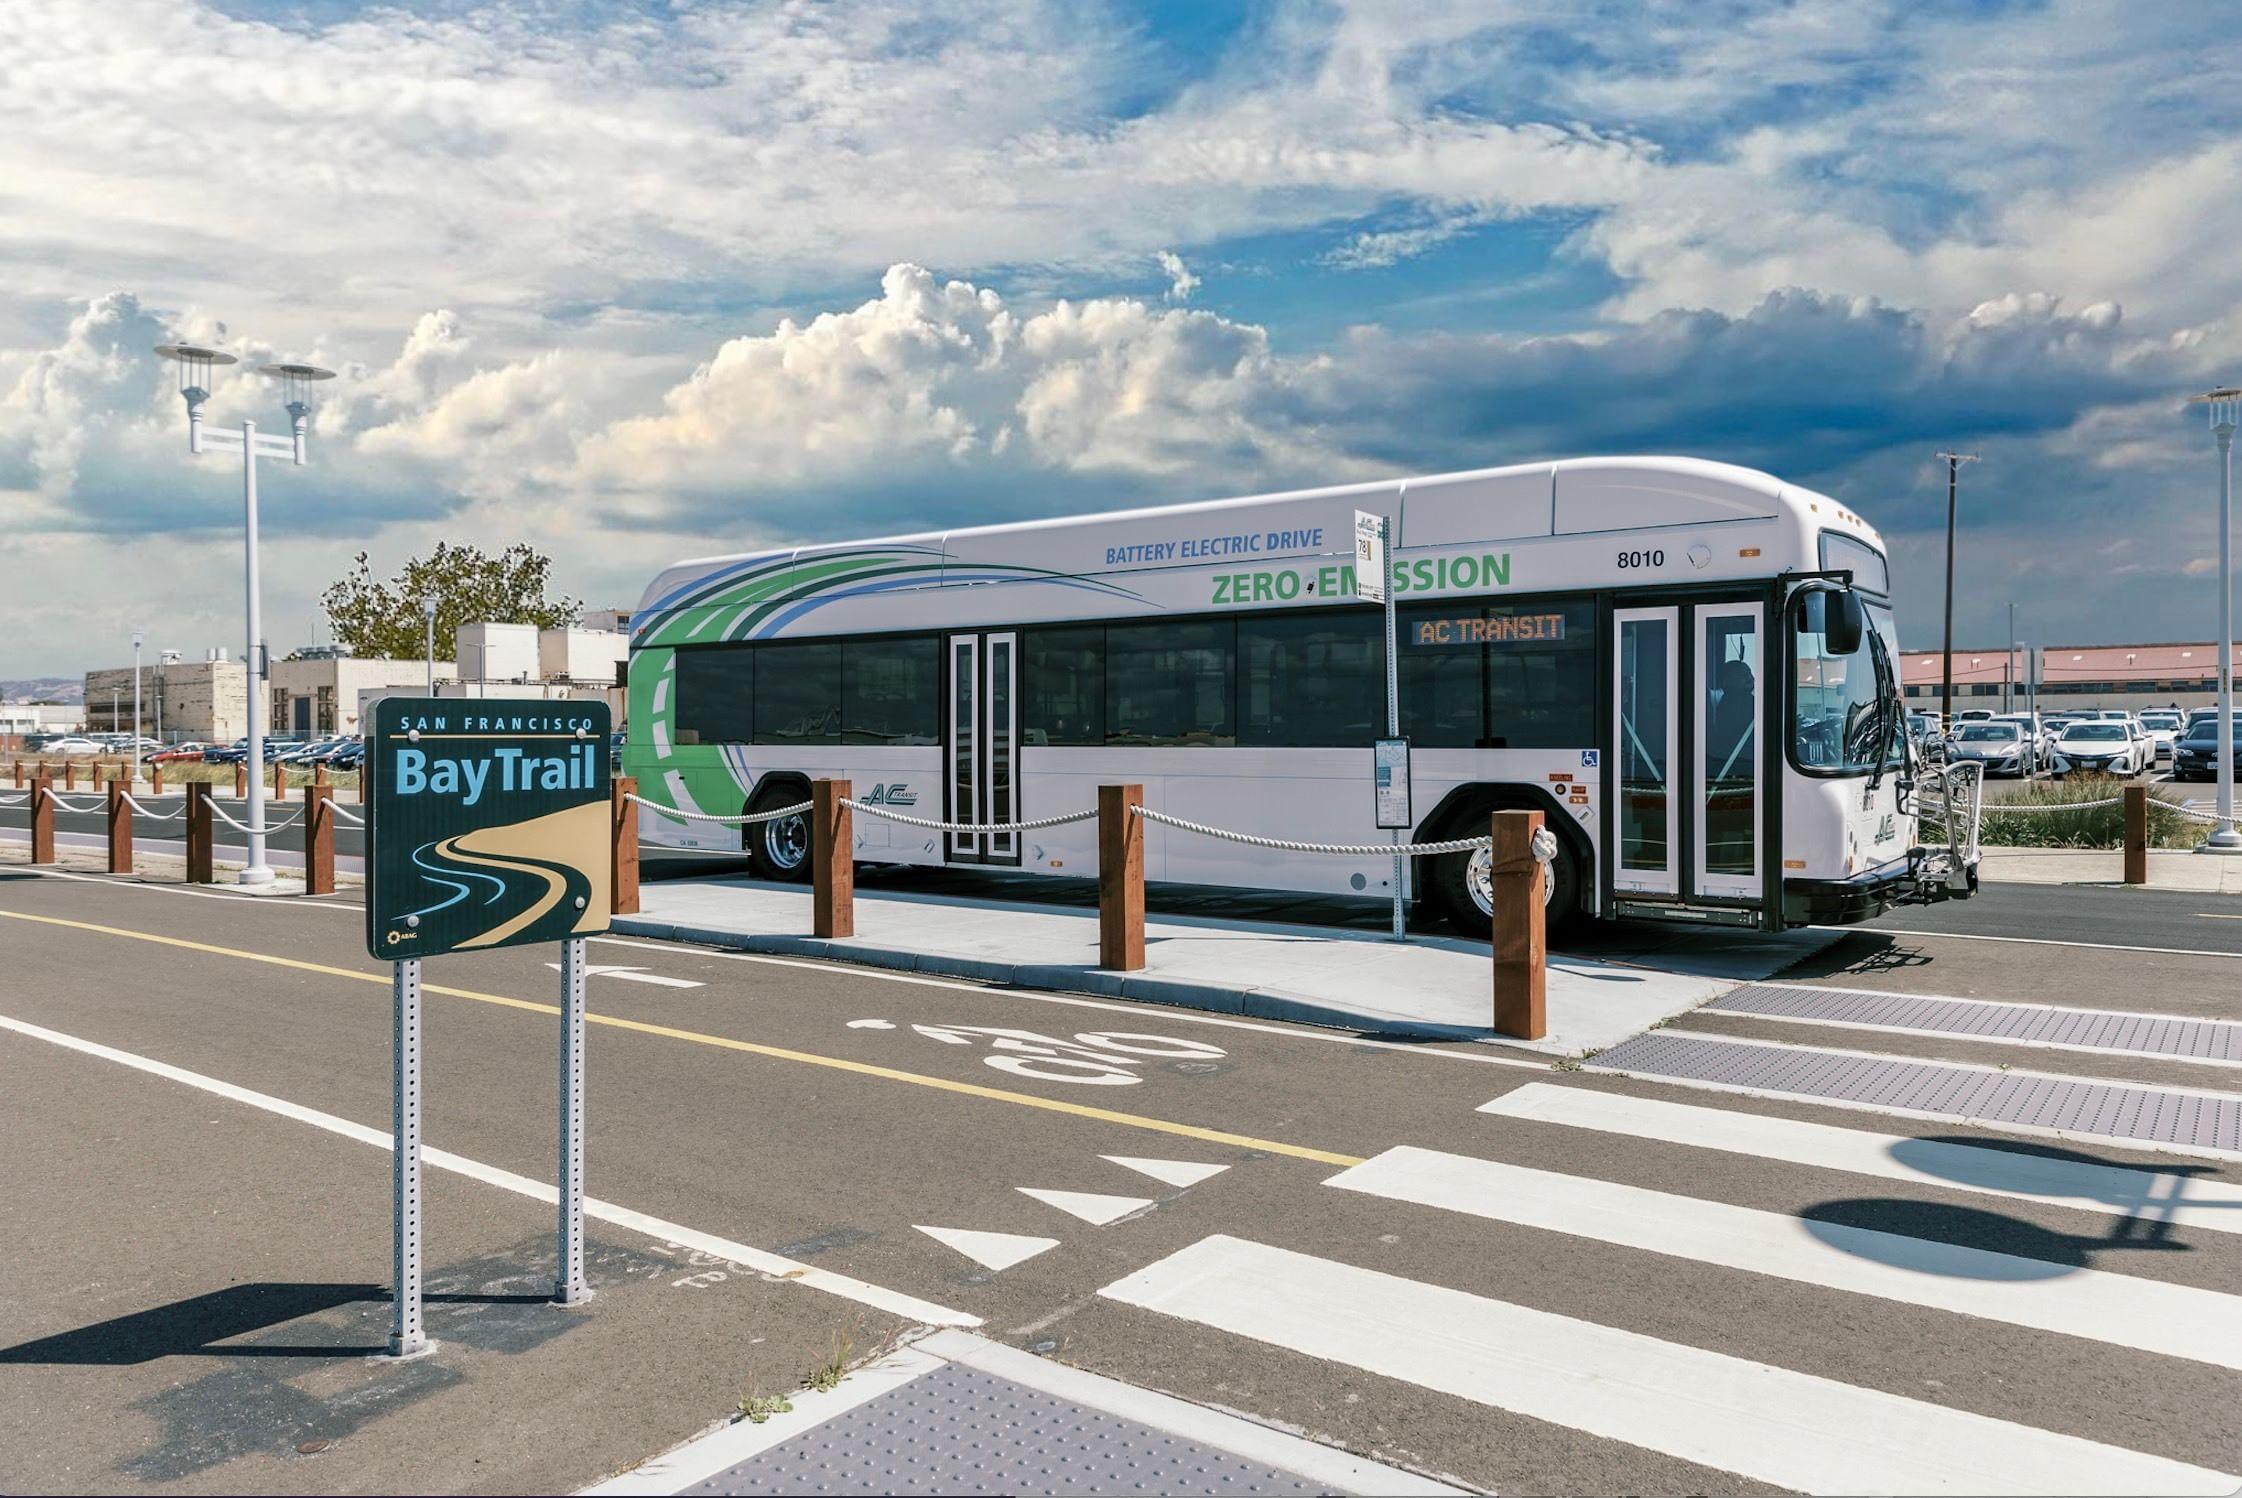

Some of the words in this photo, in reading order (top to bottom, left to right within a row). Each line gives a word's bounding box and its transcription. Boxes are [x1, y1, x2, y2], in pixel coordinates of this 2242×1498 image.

[1106, 542, 1176, 564] BATTERY
[1181, 534, 1261, 558] ELECTRIC
[1266, 528, 1323, 550] DRIVE
[1617, 550, 1665, 568] 8010
[1212, 570, 1300, 604] ZERO
[1319, 553, 1510, 597] EMSSION
[1419, 621, 1450, 644] AC
[1456, 614, 1562, 641] TRANSIT
[401, 716, 446, 730] SAN
[465, 717, 592, 730] FRANCISCO
[859, 783, 917, 806] AC
